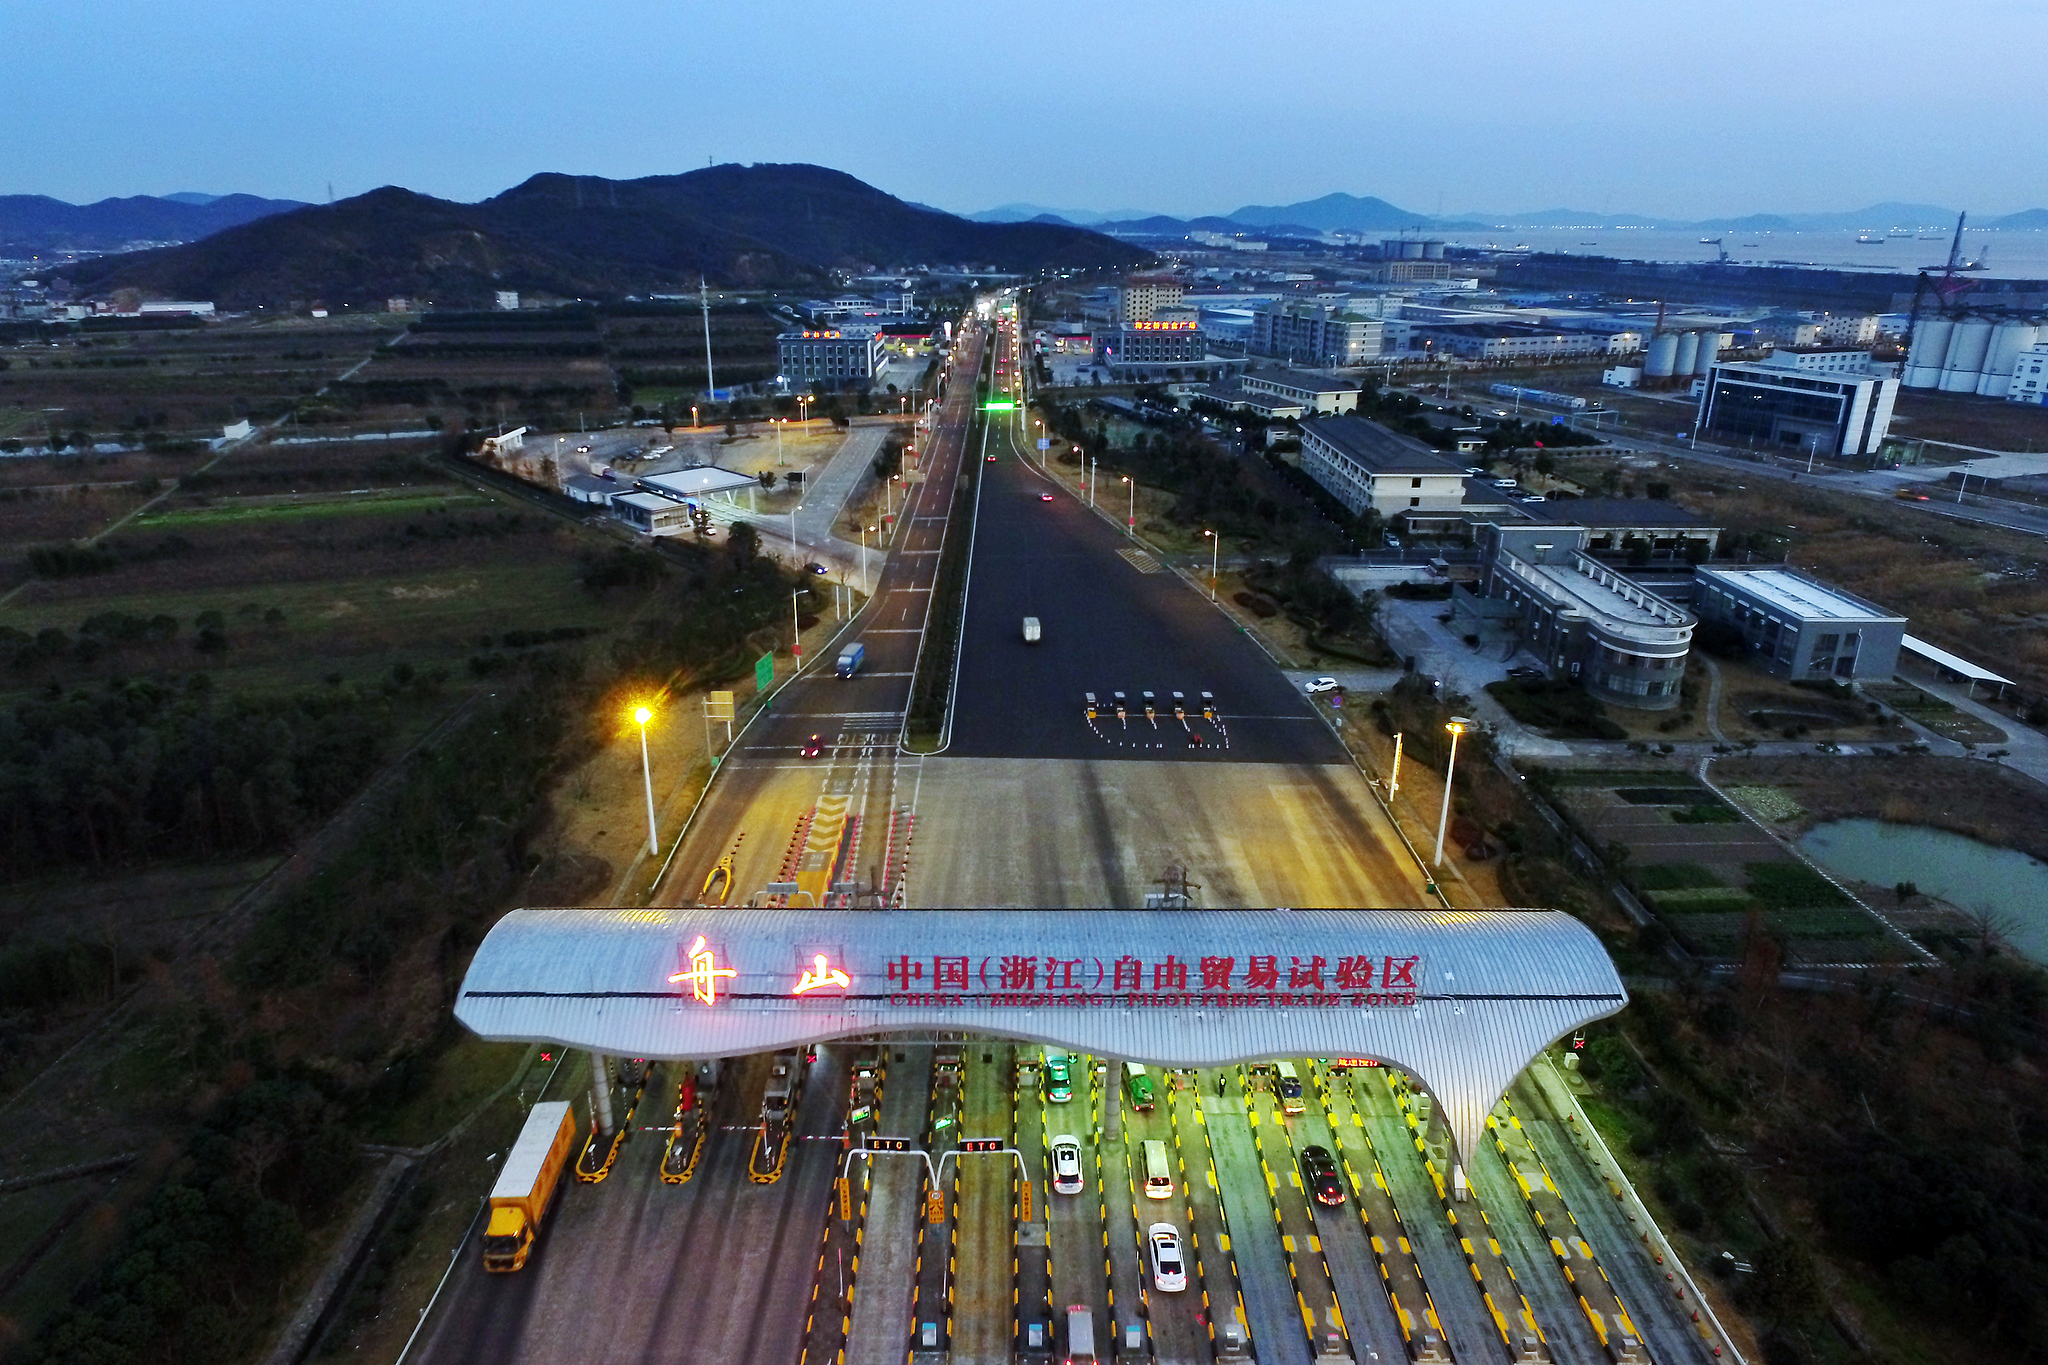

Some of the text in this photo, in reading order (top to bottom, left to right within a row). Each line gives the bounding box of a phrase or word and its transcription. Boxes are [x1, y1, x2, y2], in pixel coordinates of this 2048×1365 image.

[667, 934, 851, 1007] 舟山
[888, 954, 1421, 991] 中国(浙江)自由贸易试验区
[890, 992, 964, 1007] CHINA
[1127, 992, 1194, 1007] PILOT
[1201, 992, 1260, 1007] FREE
[1267, 992, 1341, 1007] TRADE
[1352, 992, 1417, 1007] ZONE
[873, 1140, 903, 1150] ETC
[966, 1141, 996, 1152] ETC
